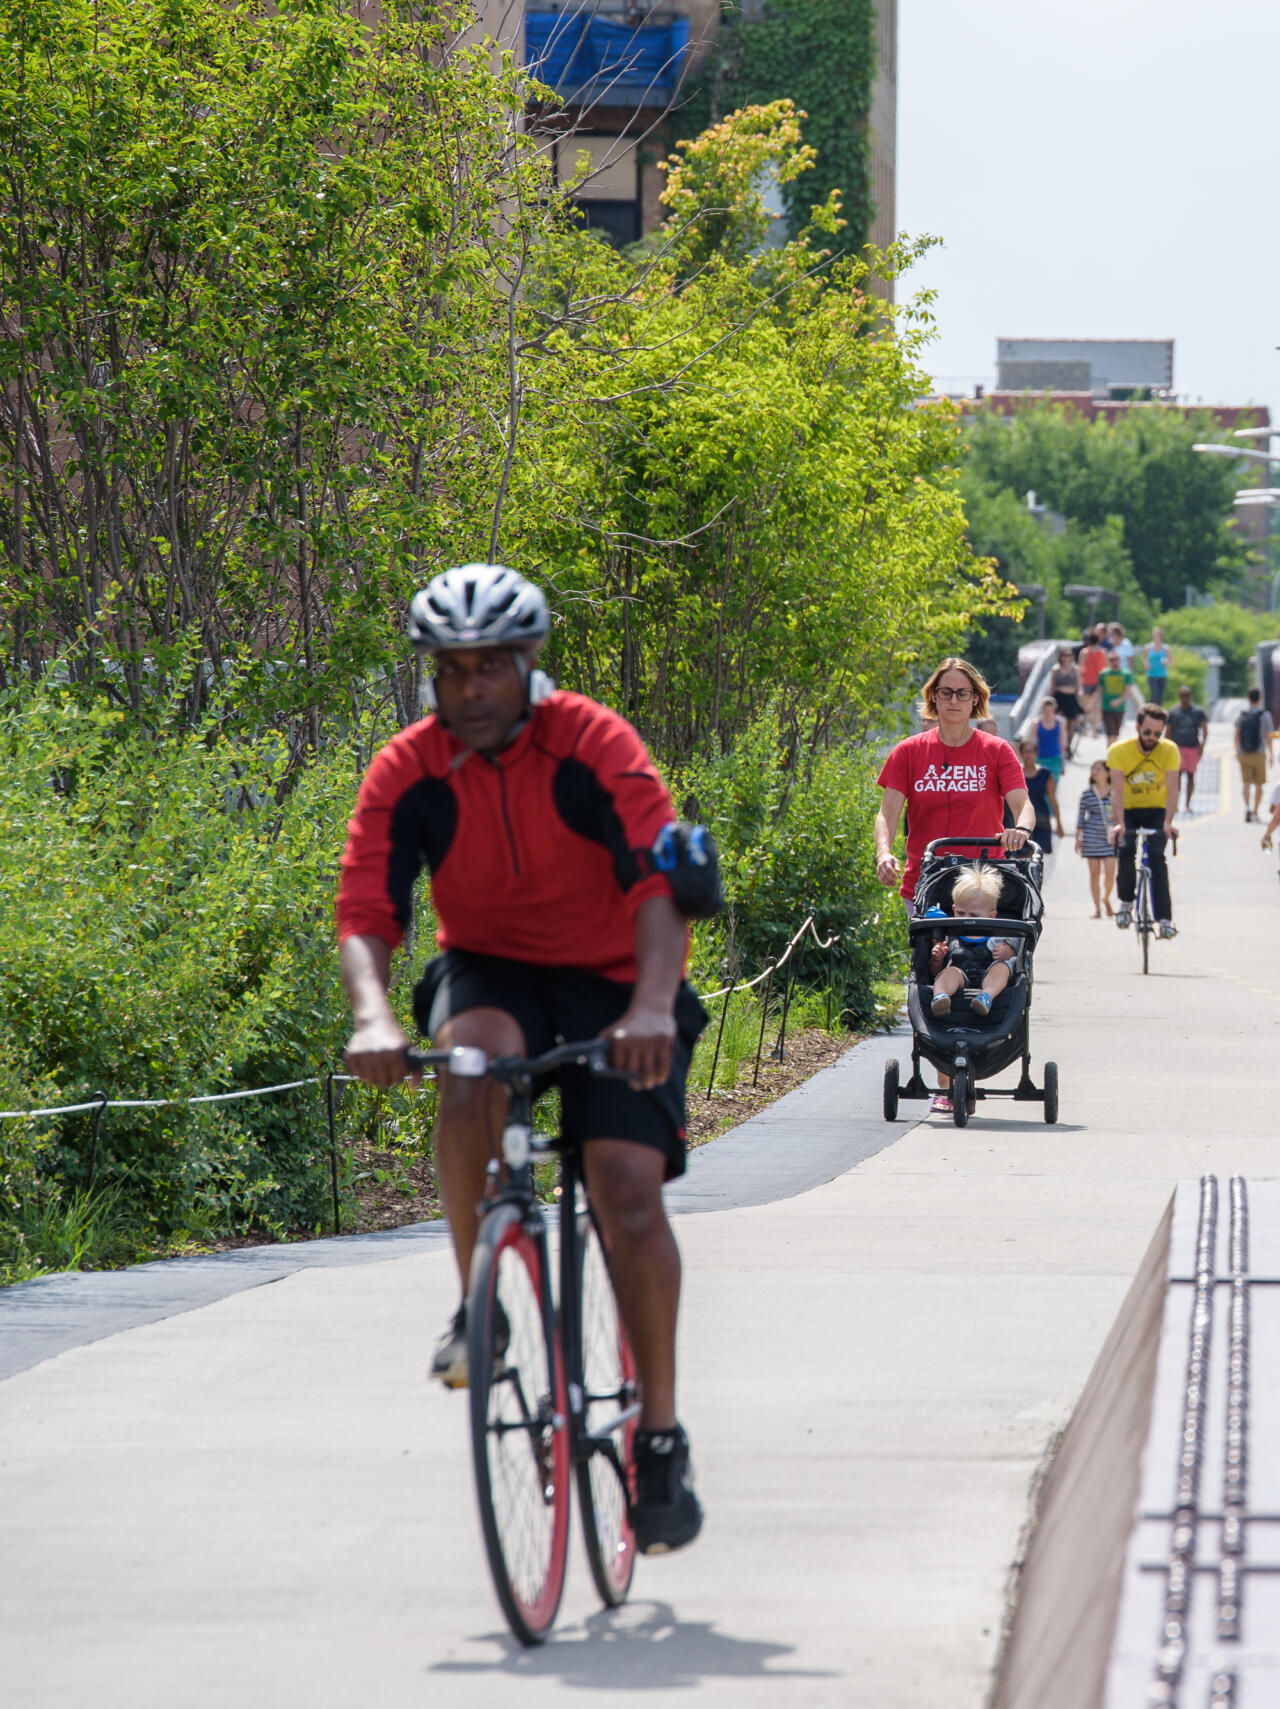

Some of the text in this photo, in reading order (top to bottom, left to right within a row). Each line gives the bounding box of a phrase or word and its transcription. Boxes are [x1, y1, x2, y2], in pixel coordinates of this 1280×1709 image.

[940, 765, 977, 779] ZEN
[978, 765, 987, 792] YOGA
[914, 779, 978, 792] GARAGE
